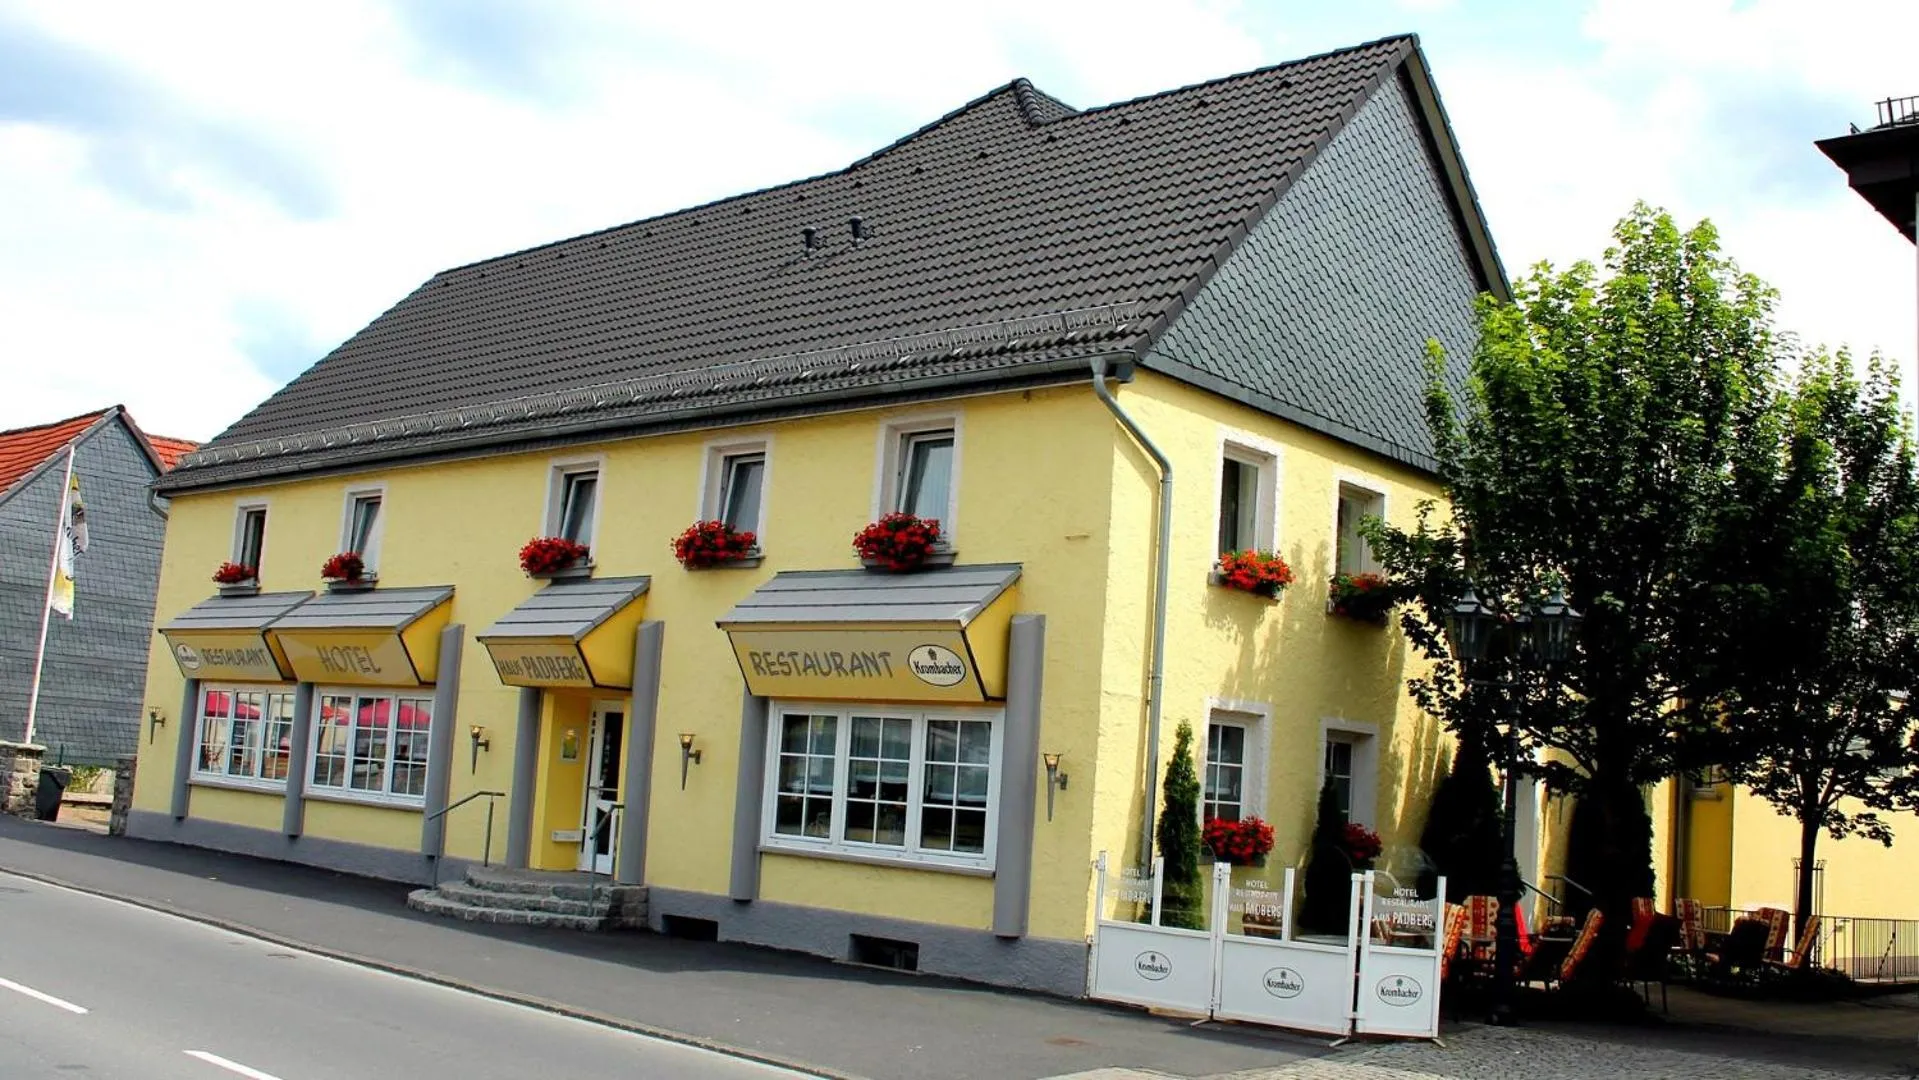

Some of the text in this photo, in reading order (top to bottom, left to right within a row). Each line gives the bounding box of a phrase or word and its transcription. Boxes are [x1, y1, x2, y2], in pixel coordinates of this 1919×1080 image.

[201, 647, 269, 667] RESTAURANT
[317, 645, 381, 674] HOTEL
[748, 651, 895, 679] RESTAURANT
[521, 655, 586, 680] PADBERG
[913, 660, 962, 675] Krombacher
[1245, 879, 1269, 889] HOTEL
[1393, 887, 1419, 898] HOTEL
[1392, 911, 1434, 928] PADBERG
[1266, 979, 1301, 992] Krombacher
[1380, 986, 1419, 999] Krombacher
